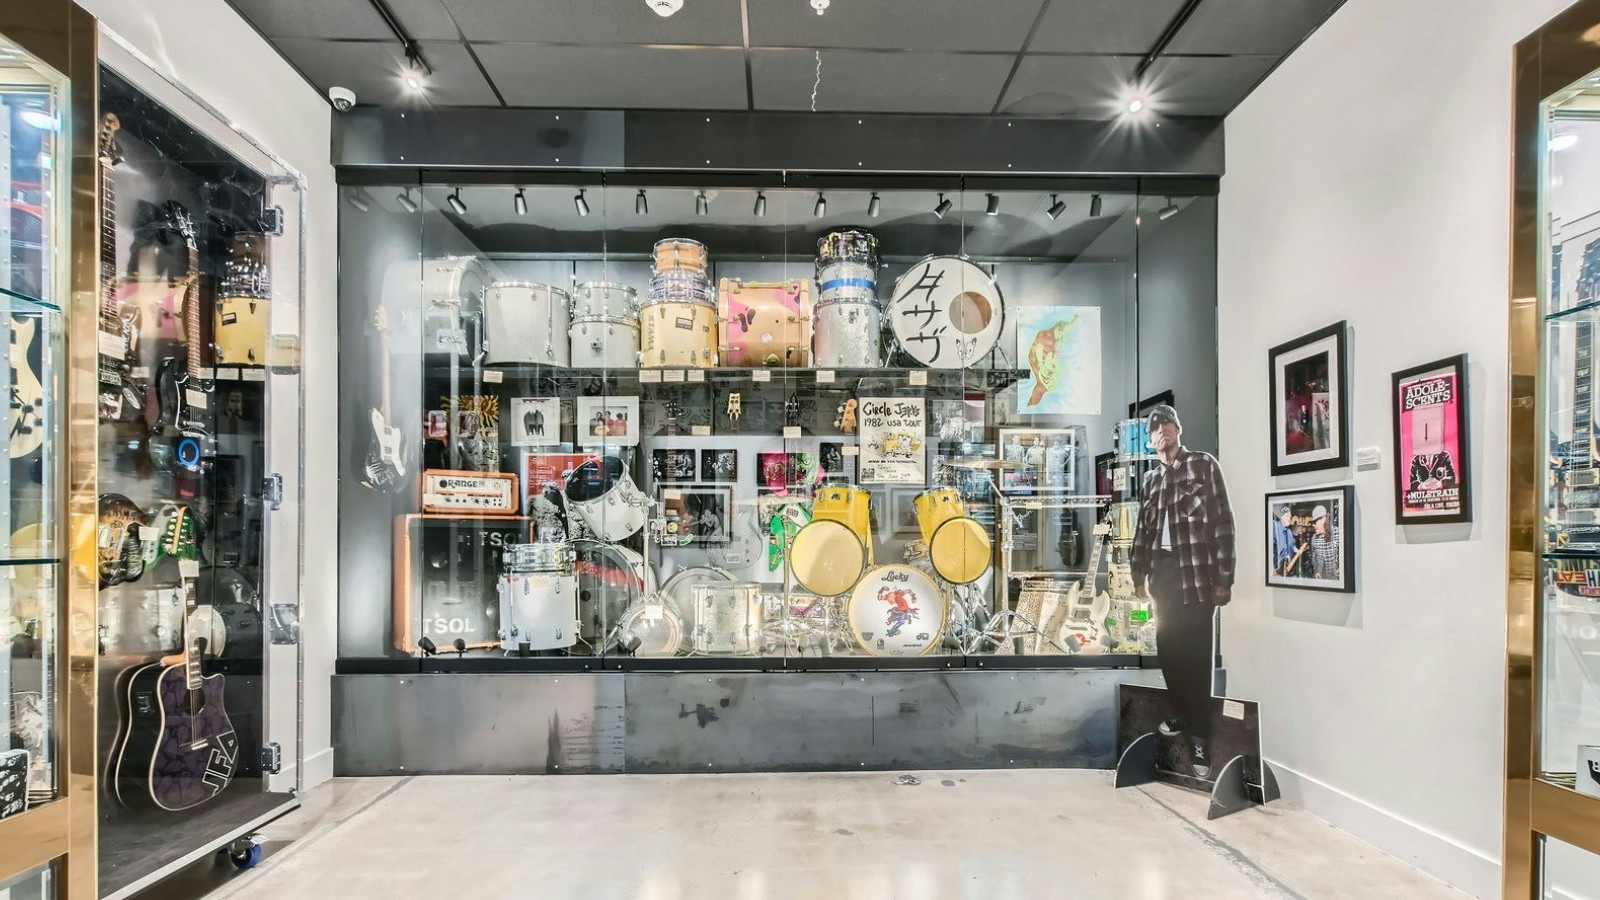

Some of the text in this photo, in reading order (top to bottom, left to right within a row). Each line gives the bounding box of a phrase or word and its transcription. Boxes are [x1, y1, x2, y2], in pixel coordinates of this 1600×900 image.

[1406, 381, 1450, 400] ADOLE-
[1406, 390, 1451, 409] SCENTS
[864, 417, 884, 427] 1982
[479, 531, 522, 546] TSO
[881, 571, 909, 583] Lucky
[422, 618, 475, 634] TSOL
